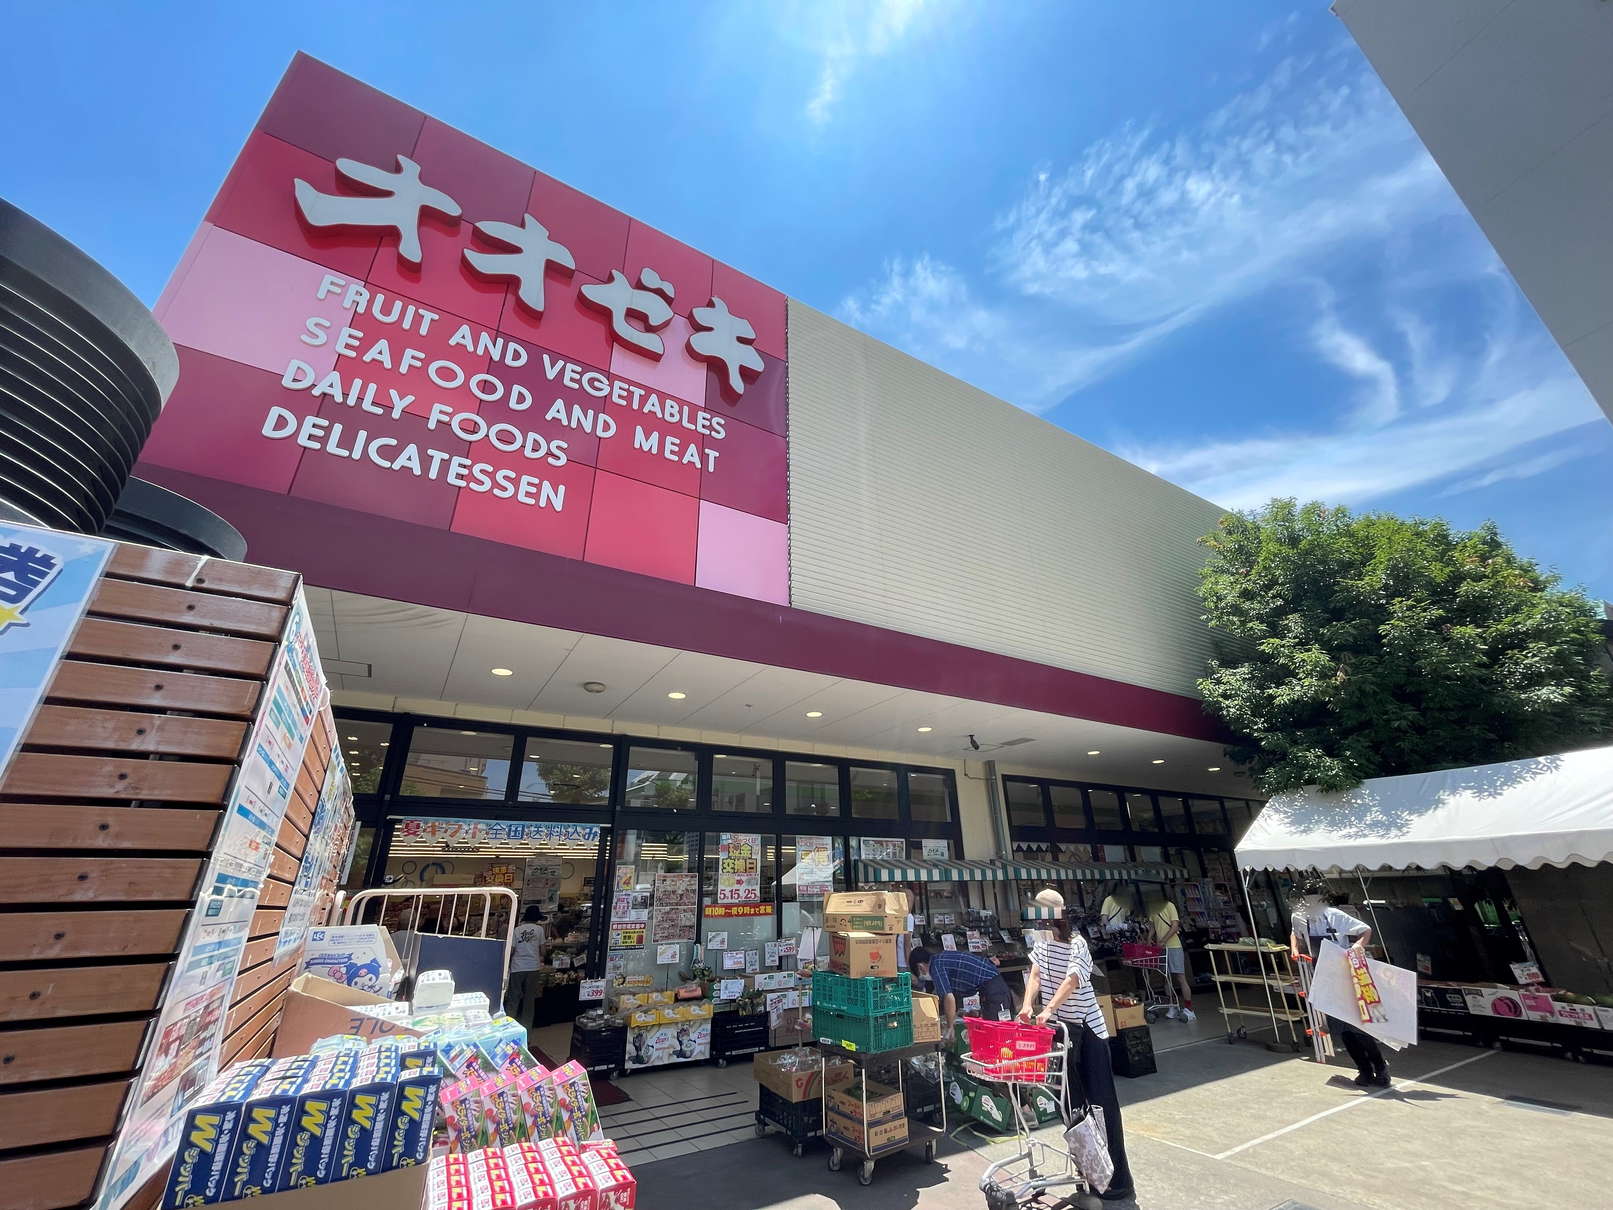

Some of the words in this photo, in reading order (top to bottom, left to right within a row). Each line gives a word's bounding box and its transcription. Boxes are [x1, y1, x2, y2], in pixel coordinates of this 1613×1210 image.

[294, 154, 766, 398] オオゼキ
[281, 358, 415, 420] DAILY
[427, 403, 569, 467] FOODS
[301, 315, 533, 412] SEAFOOD
[545, 397, 618, 439] AND
[633, 426, 721, 473] MEAT
[317, 273, 440, 337] FRUIT
[449, 323, 529, 368] AND
[543, 353, 728, 440] VEGETABLES
[262, 405, 567, 512] DELICATESSEN
[350, 1017, 408, 1034] OLE
